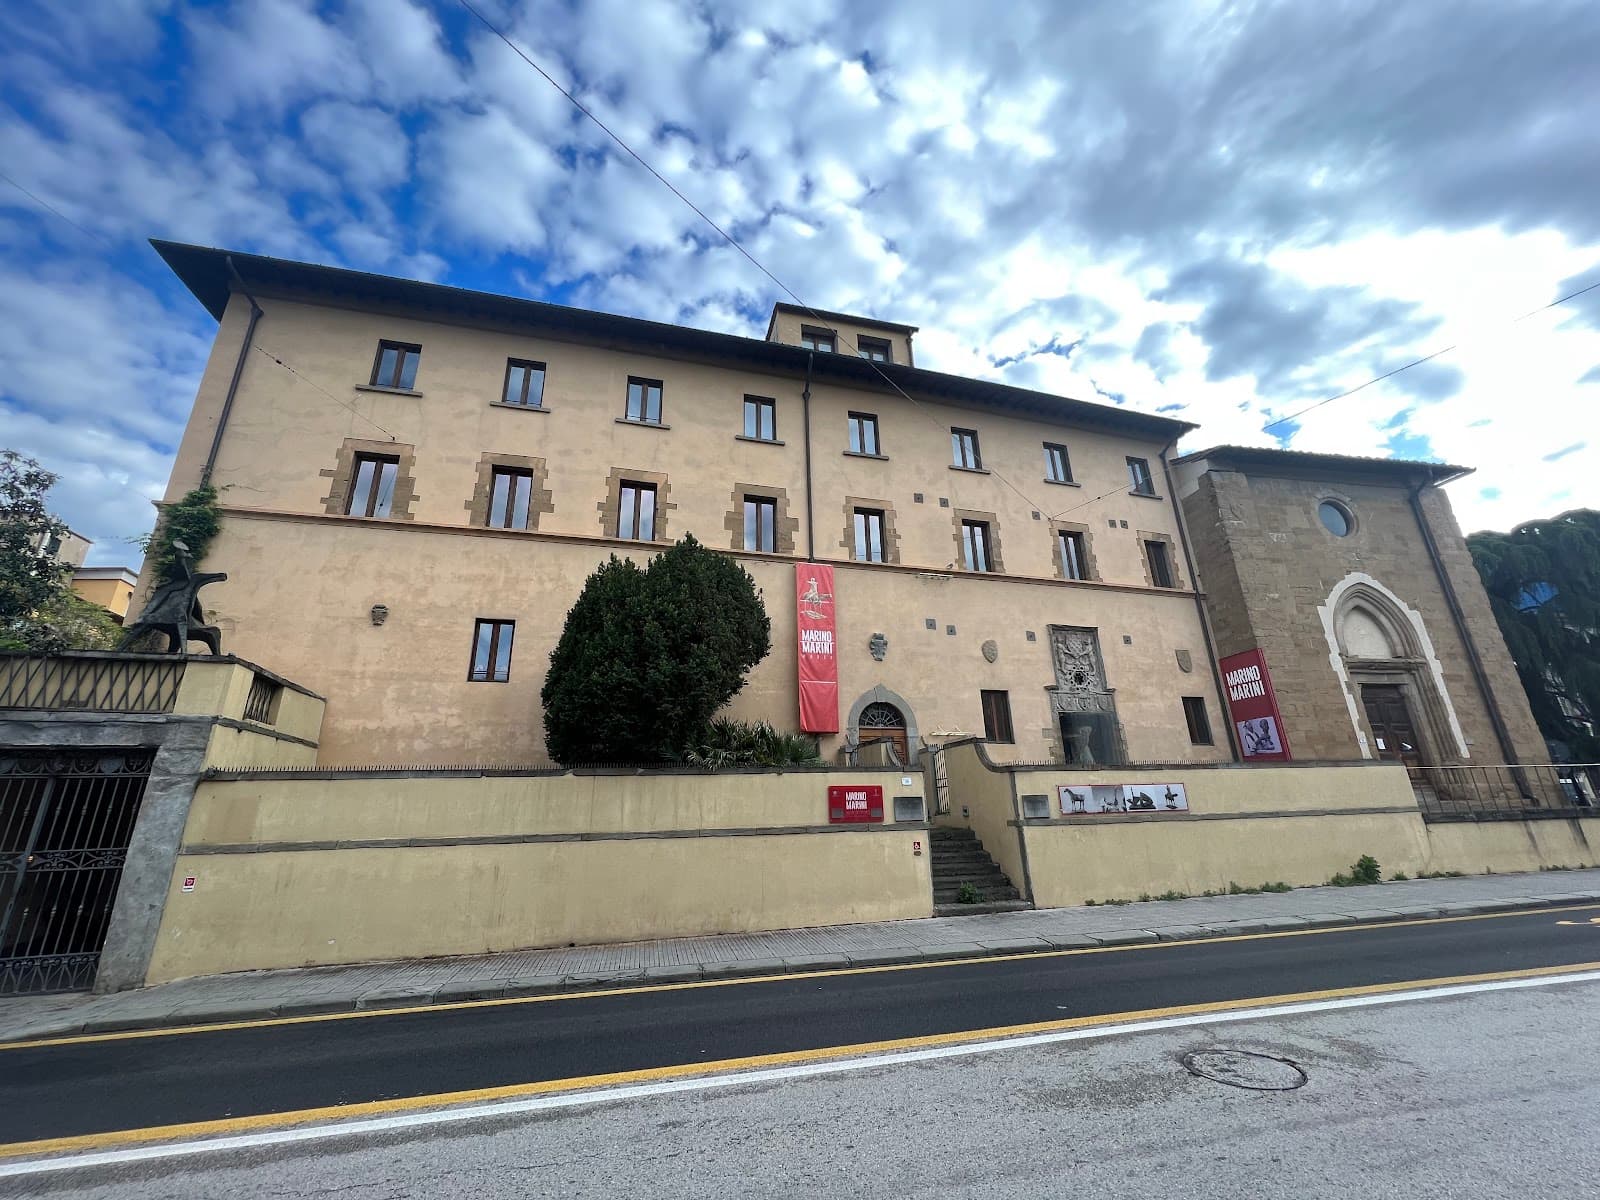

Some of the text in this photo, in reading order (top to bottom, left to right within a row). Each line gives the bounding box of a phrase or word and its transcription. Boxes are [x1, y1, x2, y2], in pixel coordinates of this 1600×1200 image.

[801, 629, 832, 641] MARINO
[802, 641, 833, 654] MARINI
[1225, 665, 1260, 687] MARINO
[1229, 680, 1266, 702] MARINI
[845, 791, 867, 800] MARINO
